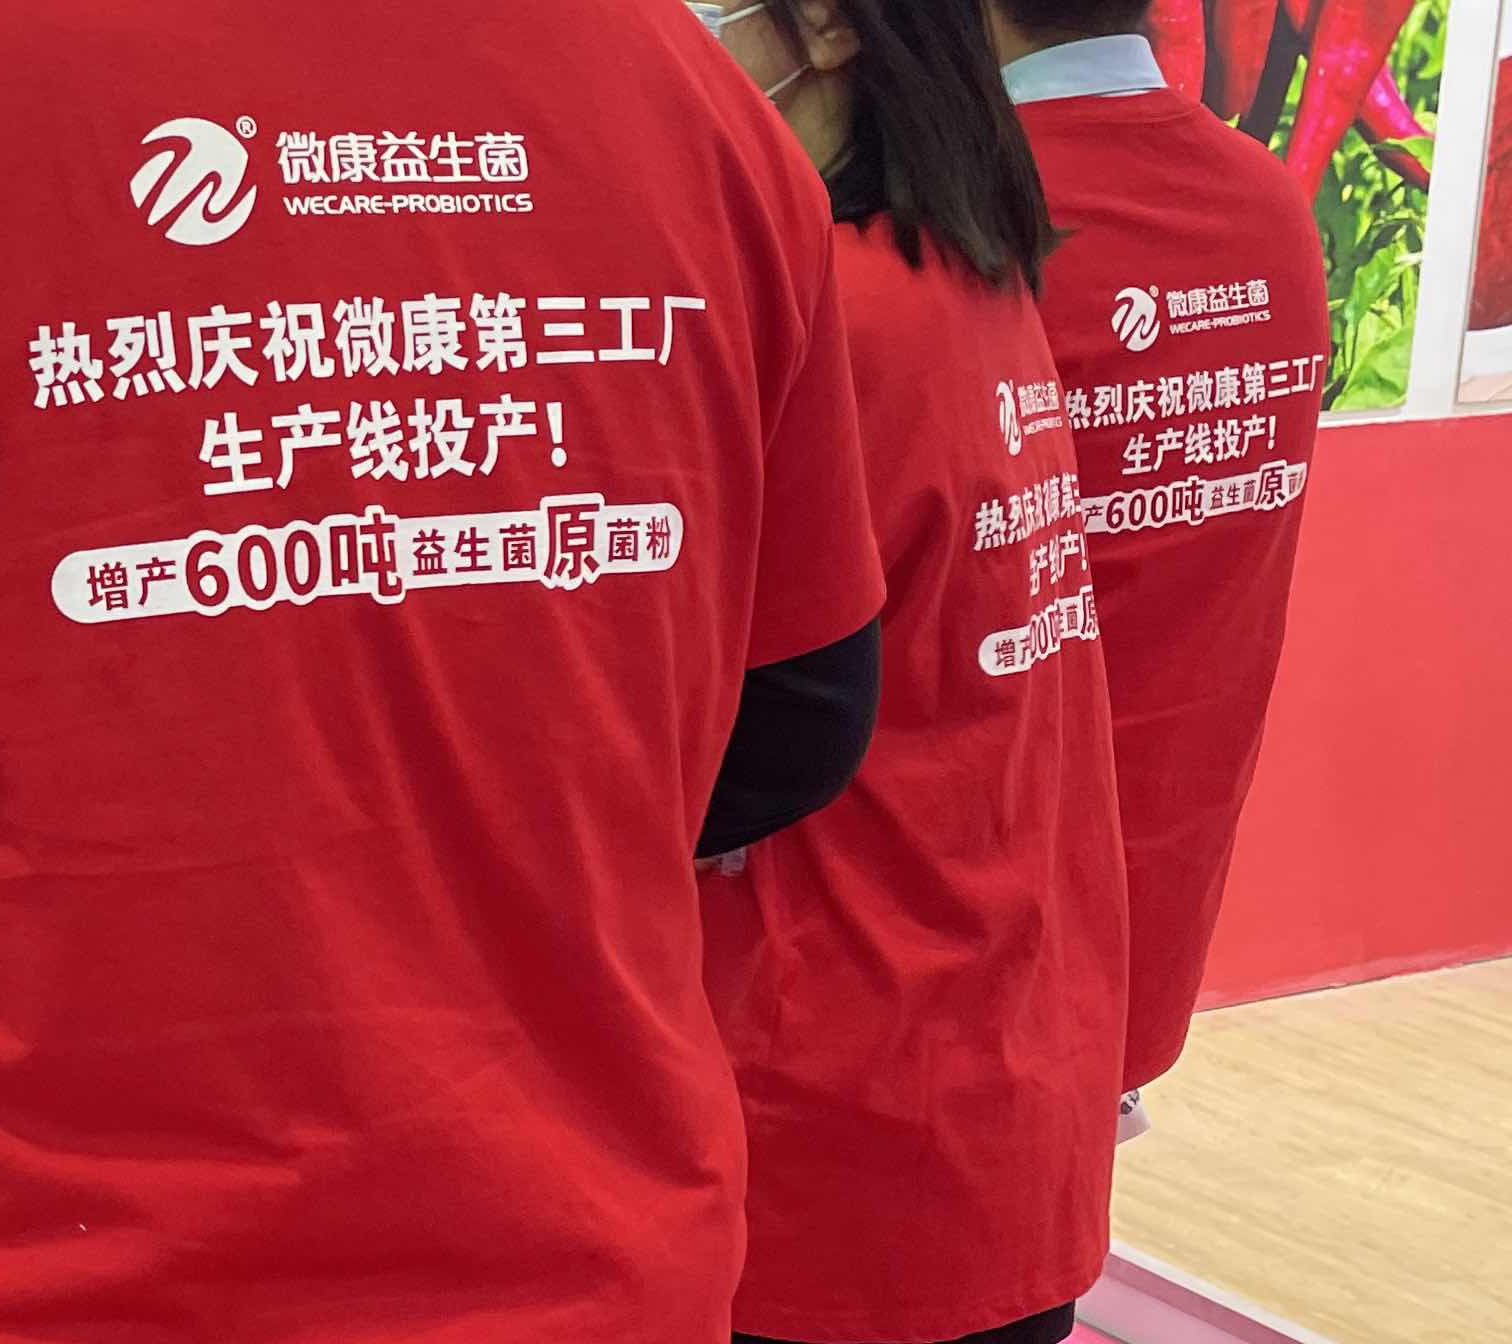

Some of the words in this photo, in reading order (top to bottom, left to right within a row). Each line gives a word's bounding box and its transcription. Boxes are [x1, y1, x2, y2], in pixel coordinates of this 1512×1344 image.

[277, 130, 528, 185] 微康益生菌
[283, 193, 534, 217] WECARE-PROBIOTICS
[1166, 279, 1270, 319] 微康益生菌
[28, 292, 707, 410] 热烈庆祝微康第三工厂
[1065, 354, 1324, 431] 热烈庆祝微康第三工厂
[198, 396, 567, 497] 生产线投产!
[1122, 415, 1276, 476] 生产线投产!
[86, 500, 672, 612] 增产600吨益生菌原菌粉
